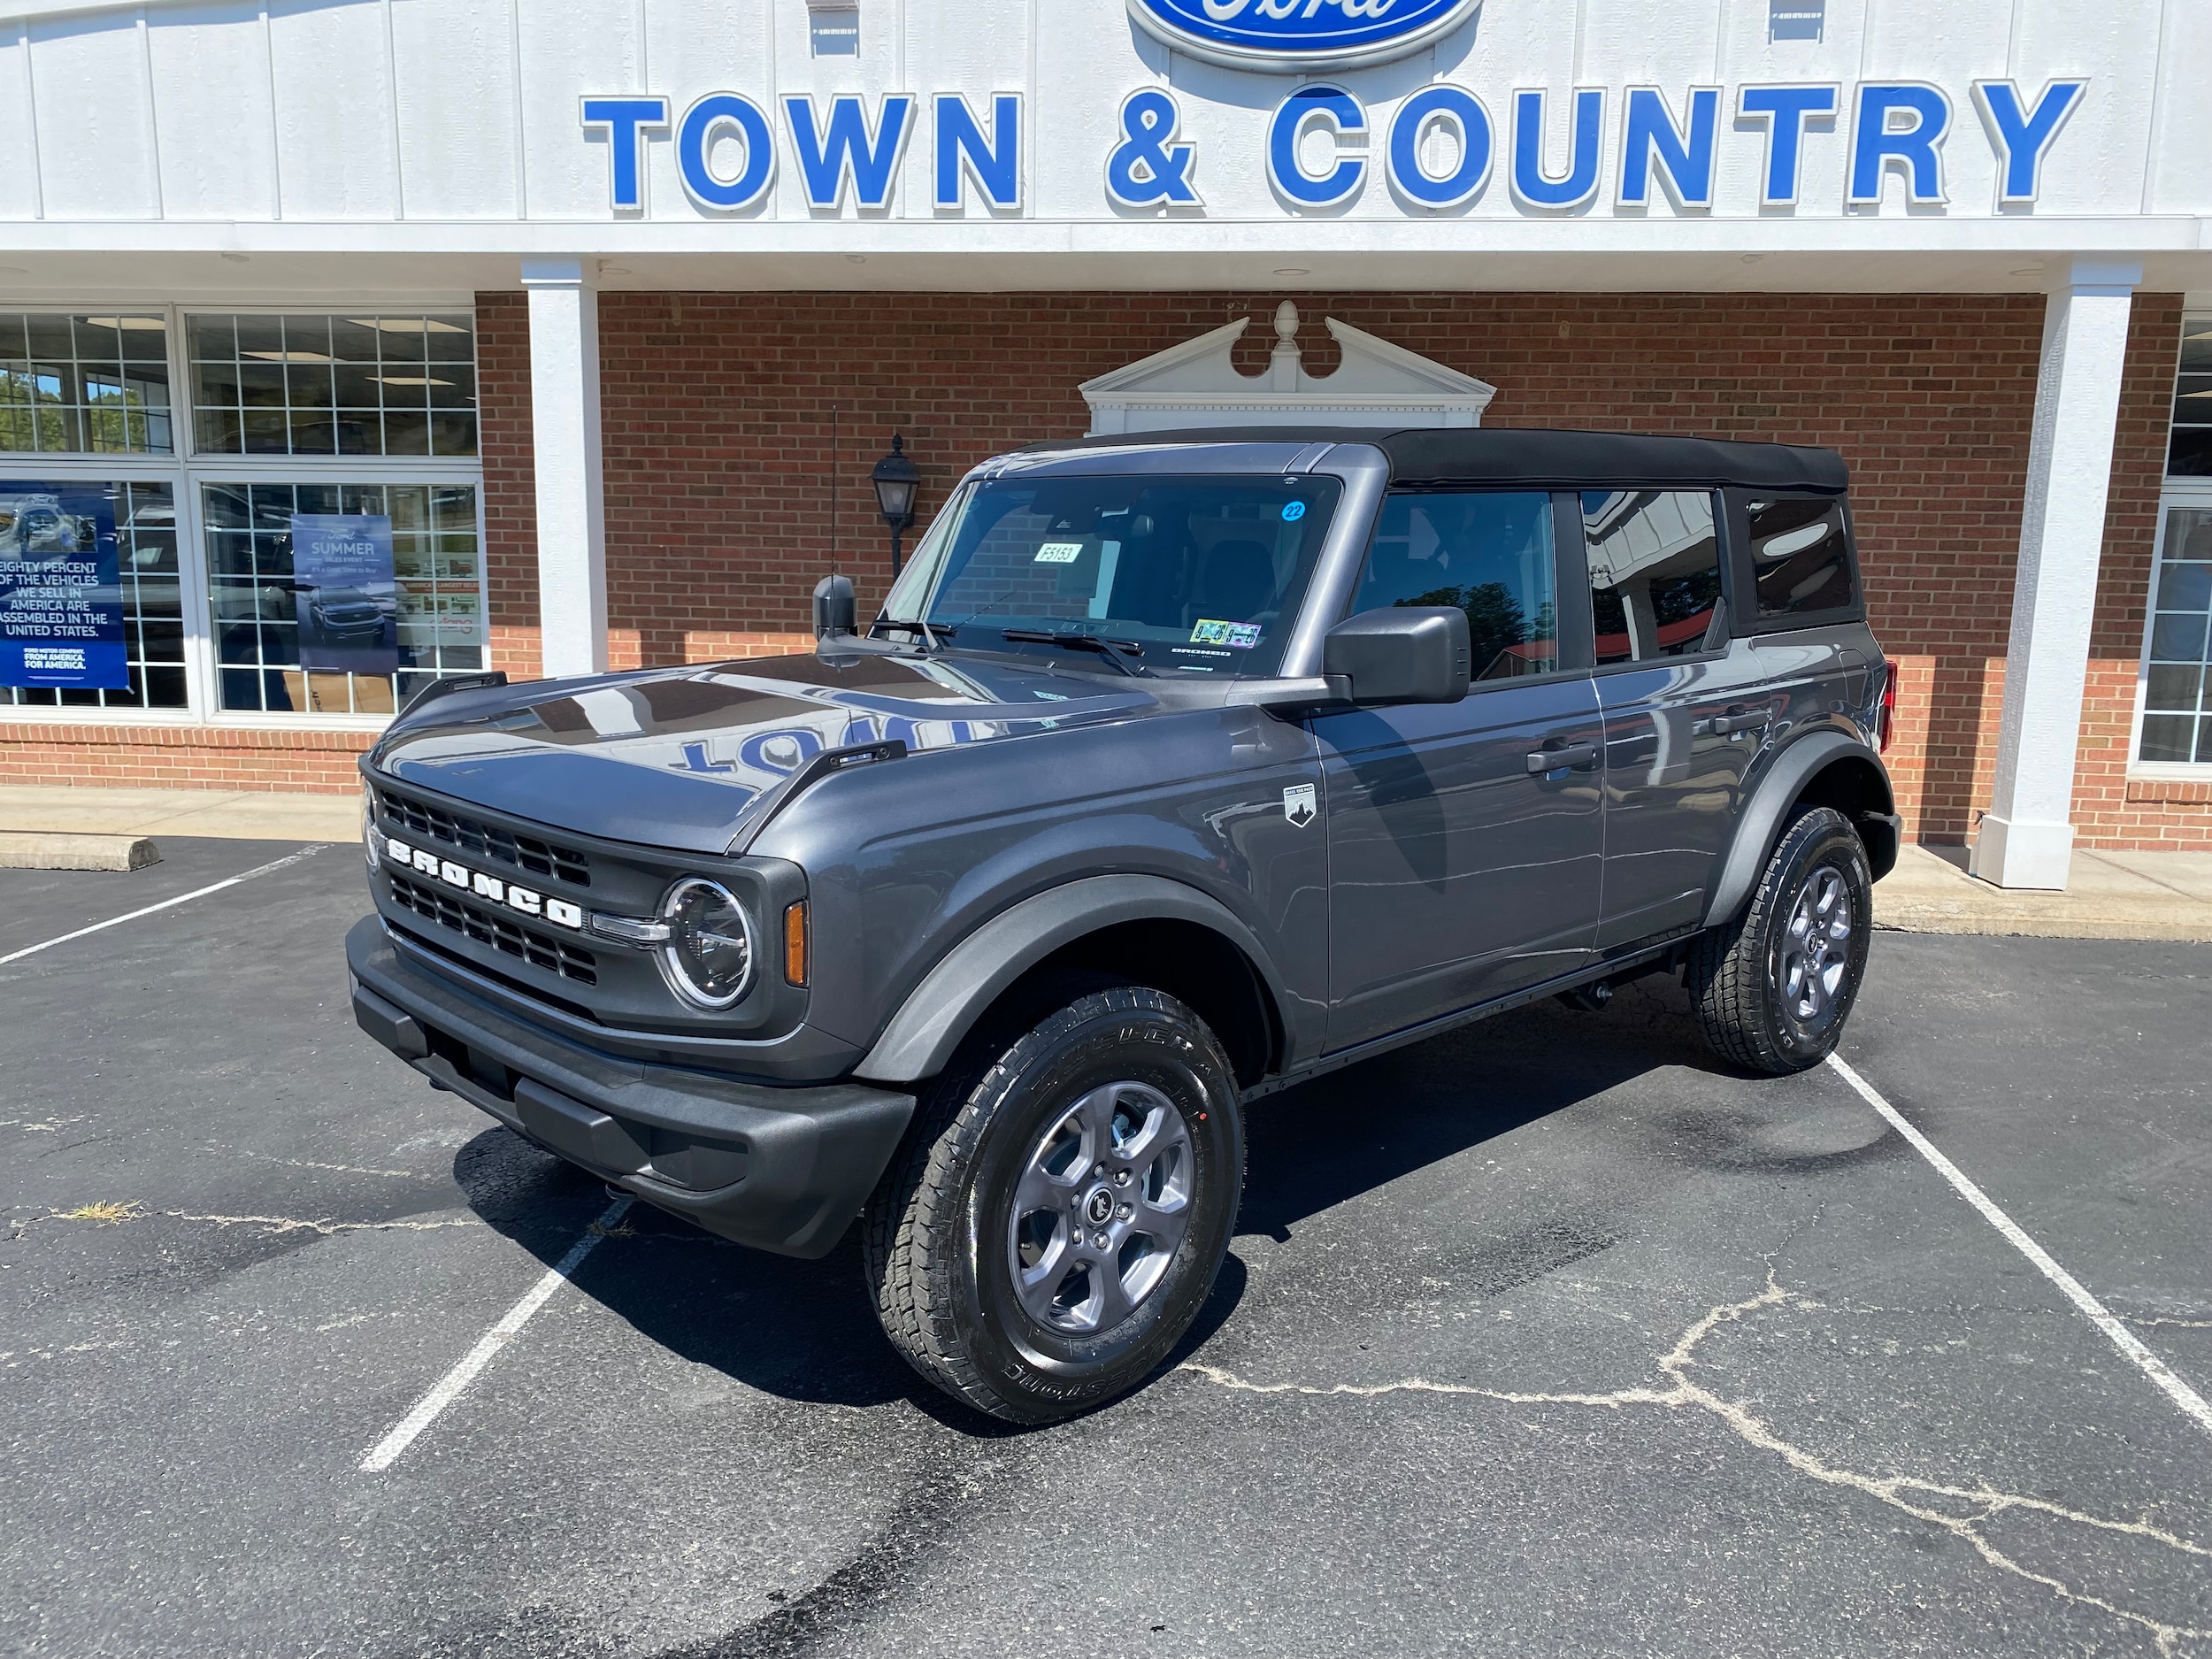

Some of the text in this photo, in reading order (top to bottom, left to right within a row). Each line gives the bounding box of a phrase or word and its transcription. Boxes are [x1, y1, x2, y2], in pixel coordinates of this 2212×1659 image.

[580, 78, 2090, 211] TOWN & COUNTRY
[1286, 505, 1302, 517] 22
[328, 527, 356, 540] Ford
[311, 542, 374, 555] SUMMER
[1040, 547, 1073, 560] F5153
[42, 562, 96, 573] PERCENT
[0, 574, 99, 586] OF THE VEHICLES
[16, 587, 81, 598] WE SELL IN
[11, 600, 90, 611] AMERICA ARE
[68, 613, 81, 623] IN
[83, 613, 107, 625] THE
[6, 625, 99, 637] UNITED STATES.
[1195, 626, 1204, 639] 9
[1226, 629, 1235, 642] 9
[1171, 648, 1231, 657] BRONCO
[45, 661, 86, 670] AMERICA.
[388, 839, 582, 929] BRONCO
